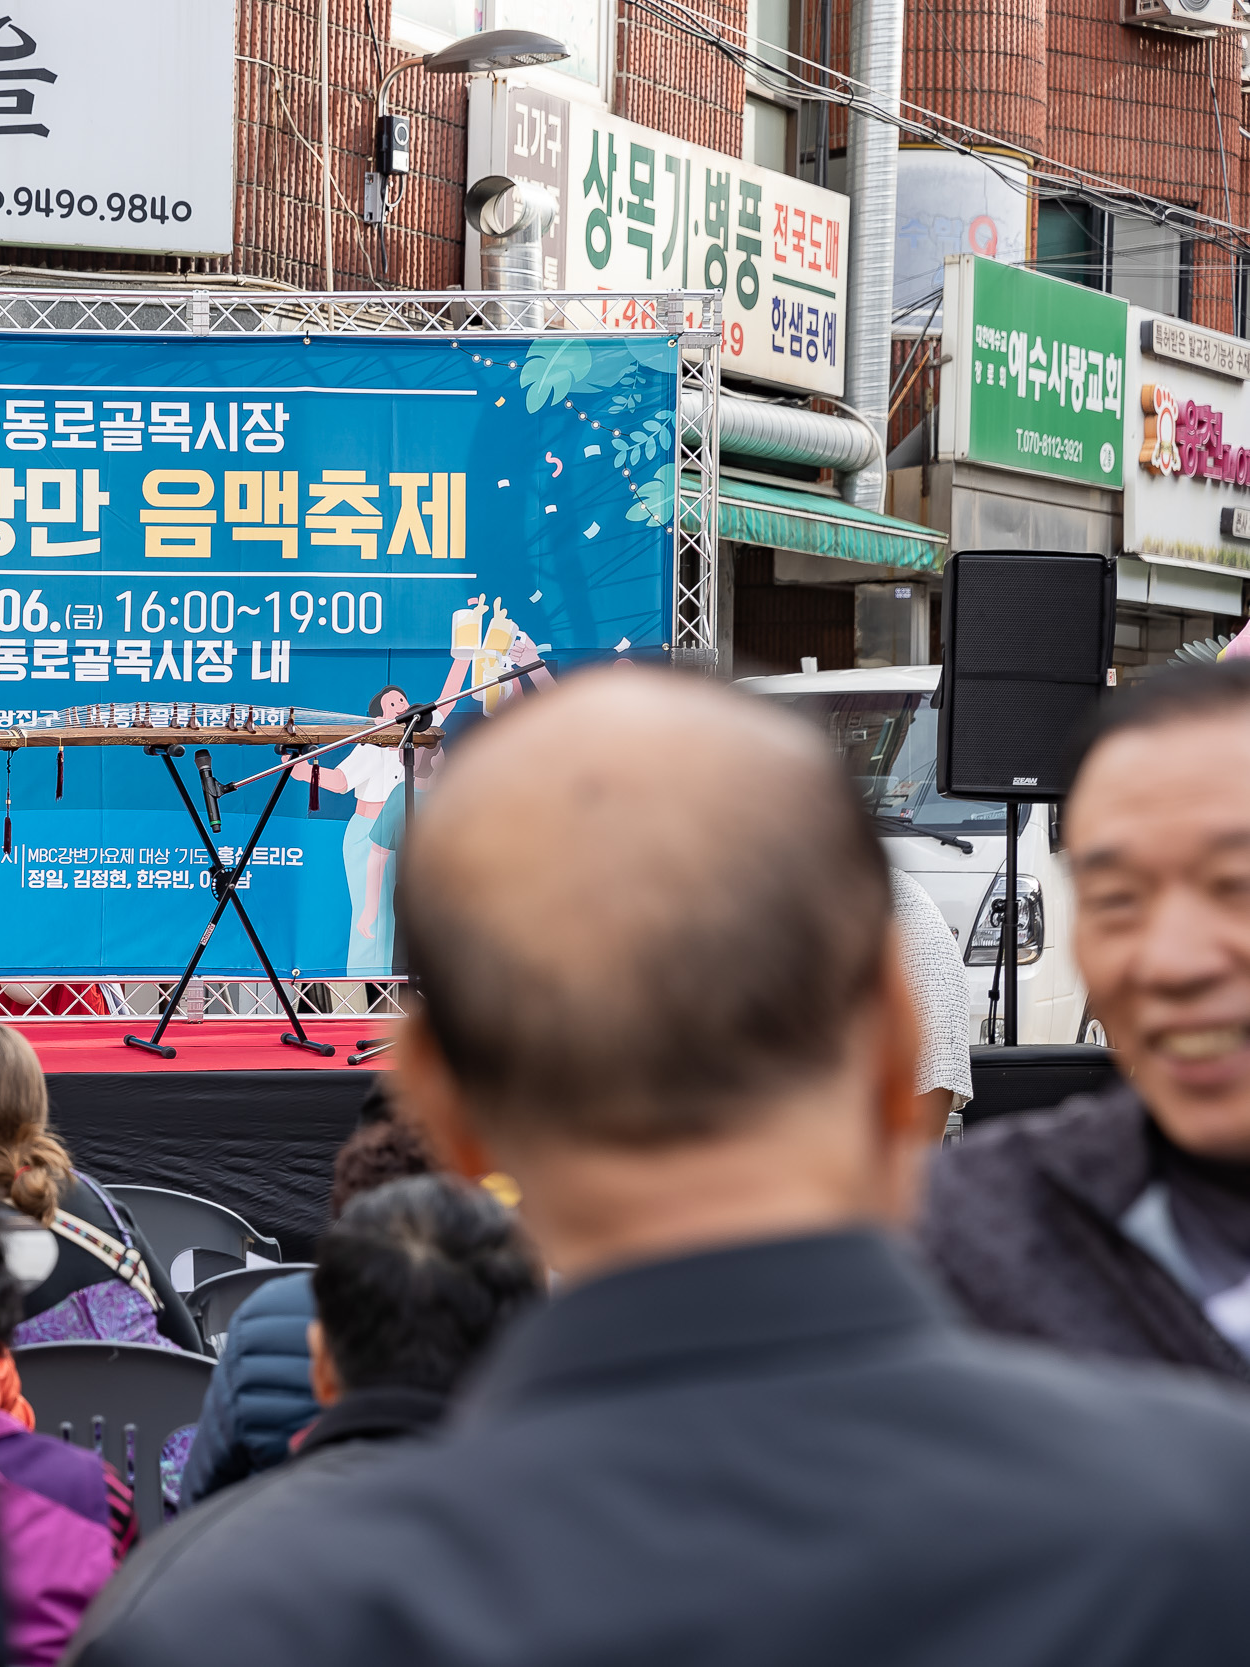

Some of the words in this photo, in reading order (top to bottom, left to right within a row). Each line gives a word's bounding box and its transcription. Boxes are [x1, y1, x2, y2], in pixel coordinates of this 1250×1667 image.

[514, 102, 562, 168] 고가구
[773, 203, 839, 279] 전국도매
[772, 296, 836, 367] 한샘공예
[976, 324, 1007, 353] 대한예수교
[1156, 324, 1185, 355] 특허받은
[1213, 342, 1234, 369] 기능성
[1008, 330, 1122, 420] 예수사랑교회
[1016, 428, 1083, 463] T.070-8112-3921
[139, 469, 467, 560] 음맥축제
[116, 590, 383, 634] 16:00~19:00
[251, 640, 291, 684] 내
[27, 847, 135, 865] MBC강변가요제
[139, 847, 170, 865] 대상
[27, 869, 68, 890] 정일,
[73, 869, 132, 890] 김정현,
[136, 869, 195, 890] 한유빈,
